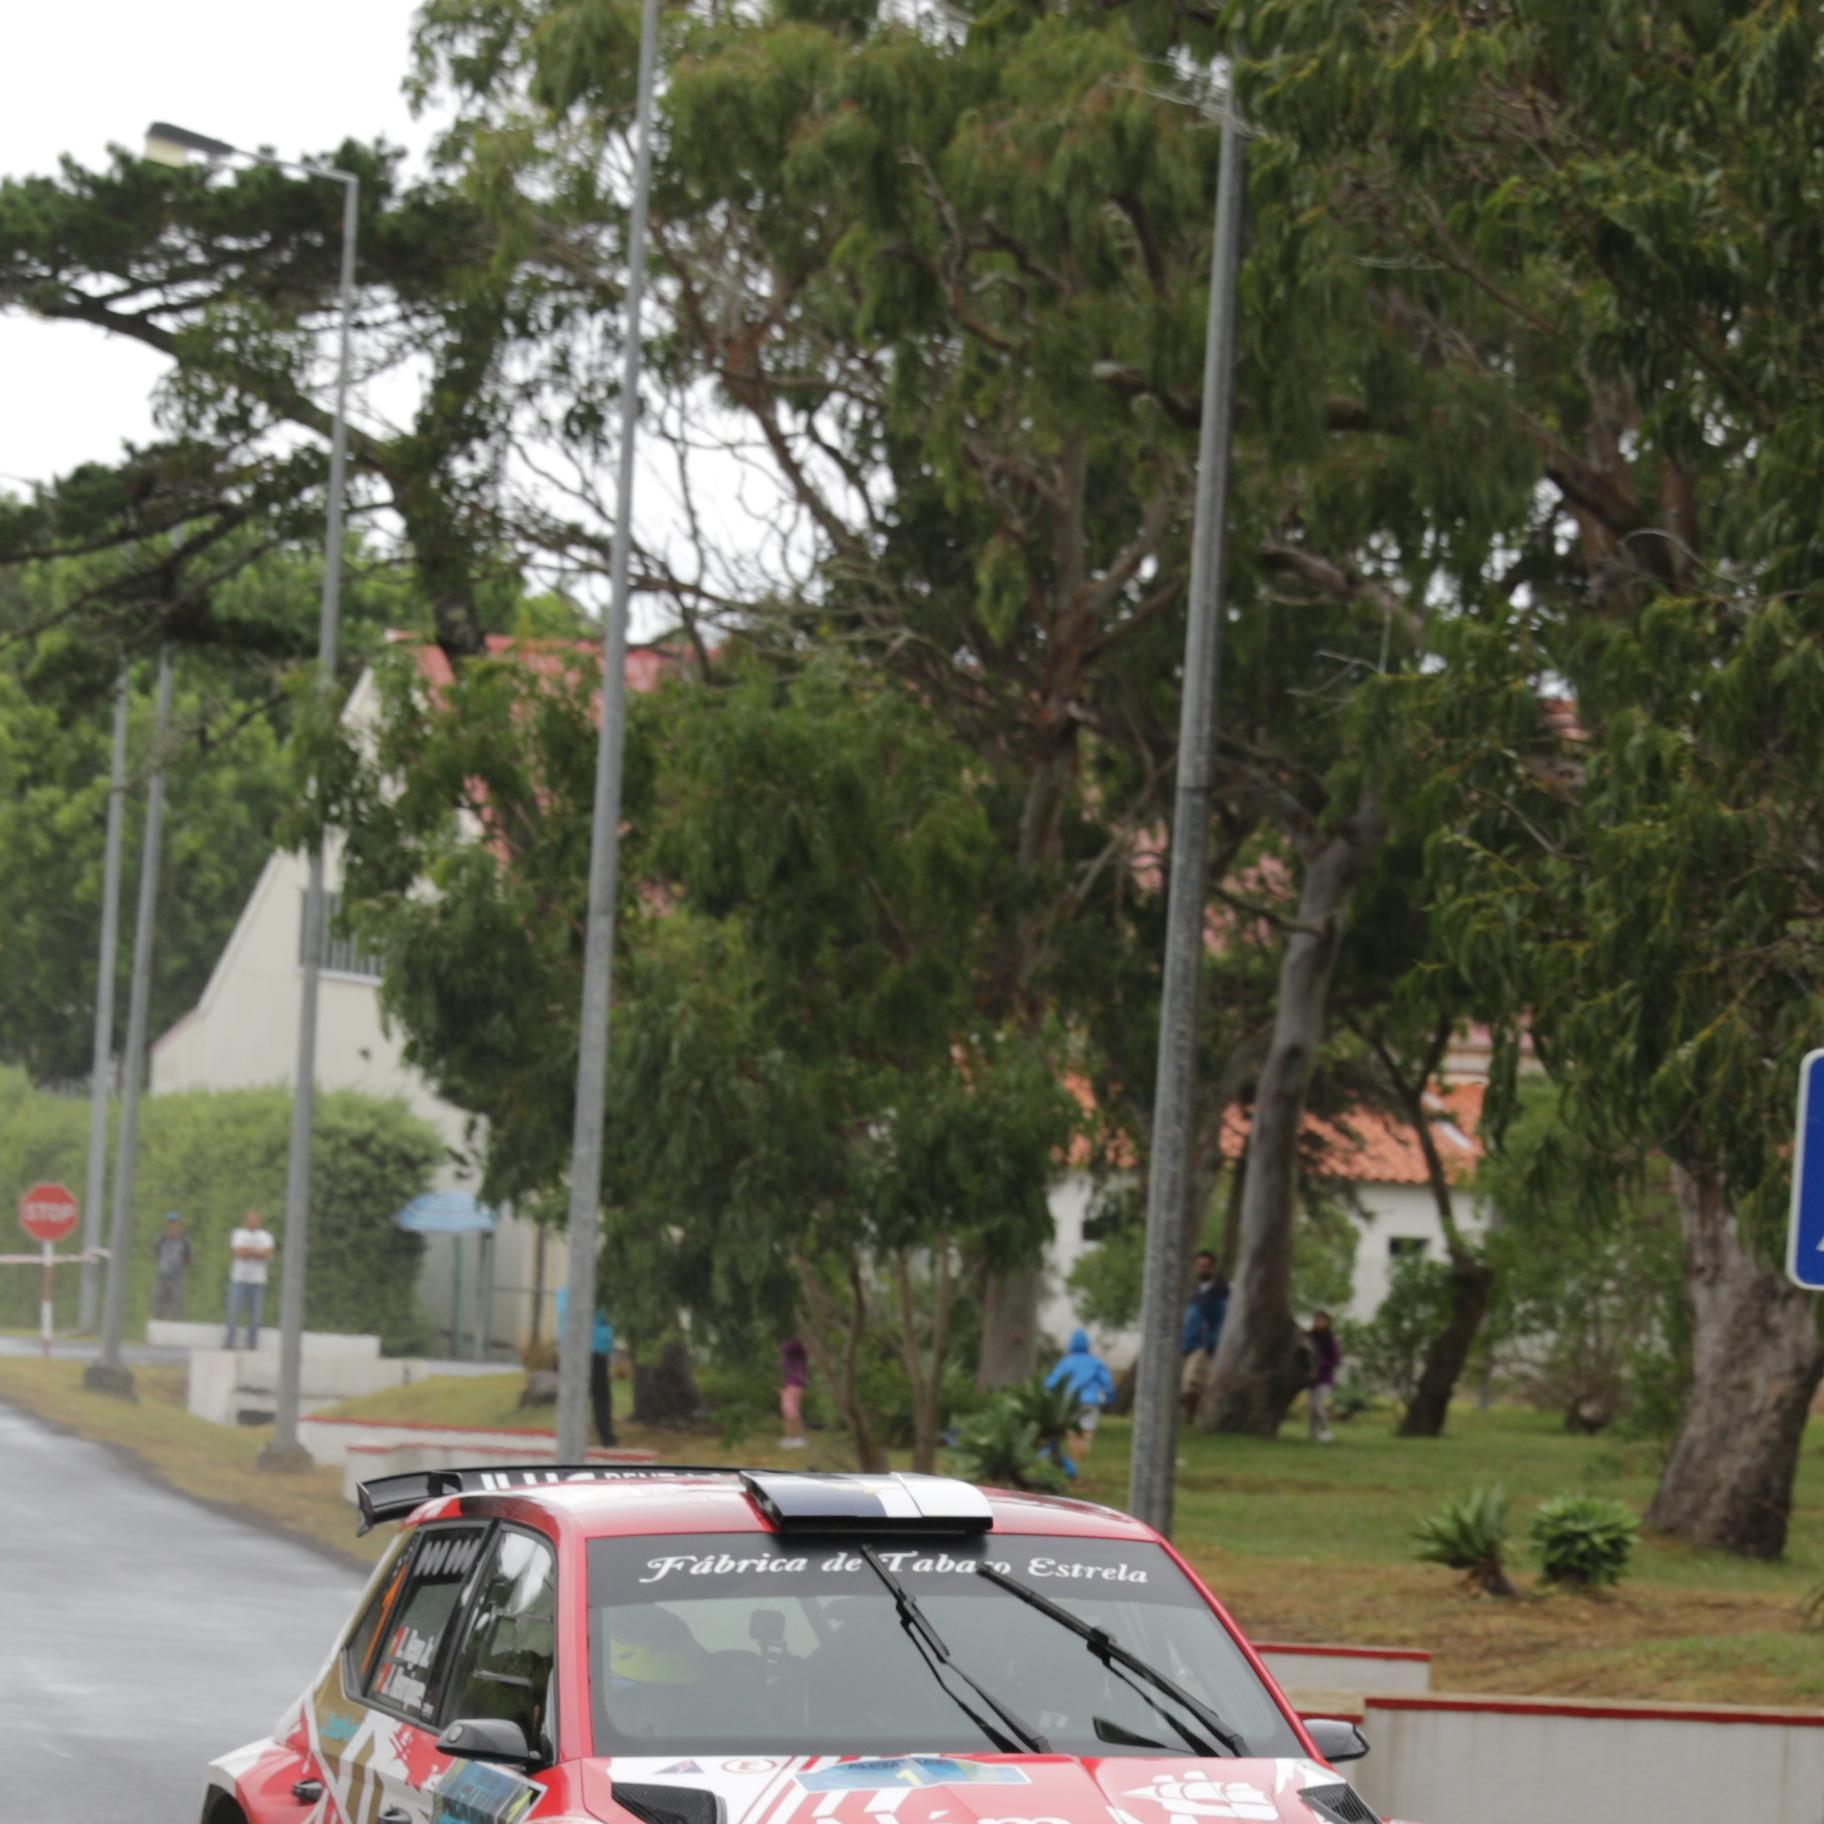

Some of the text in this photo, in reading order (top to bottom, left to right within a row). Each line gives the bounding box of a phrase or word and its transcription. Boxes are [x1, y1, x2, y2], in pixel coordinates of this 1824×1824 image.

[24, 1202, 73, 1222] STOP
[639, 1551, 1149, 1584] Fábrica de Tabao Estrela
